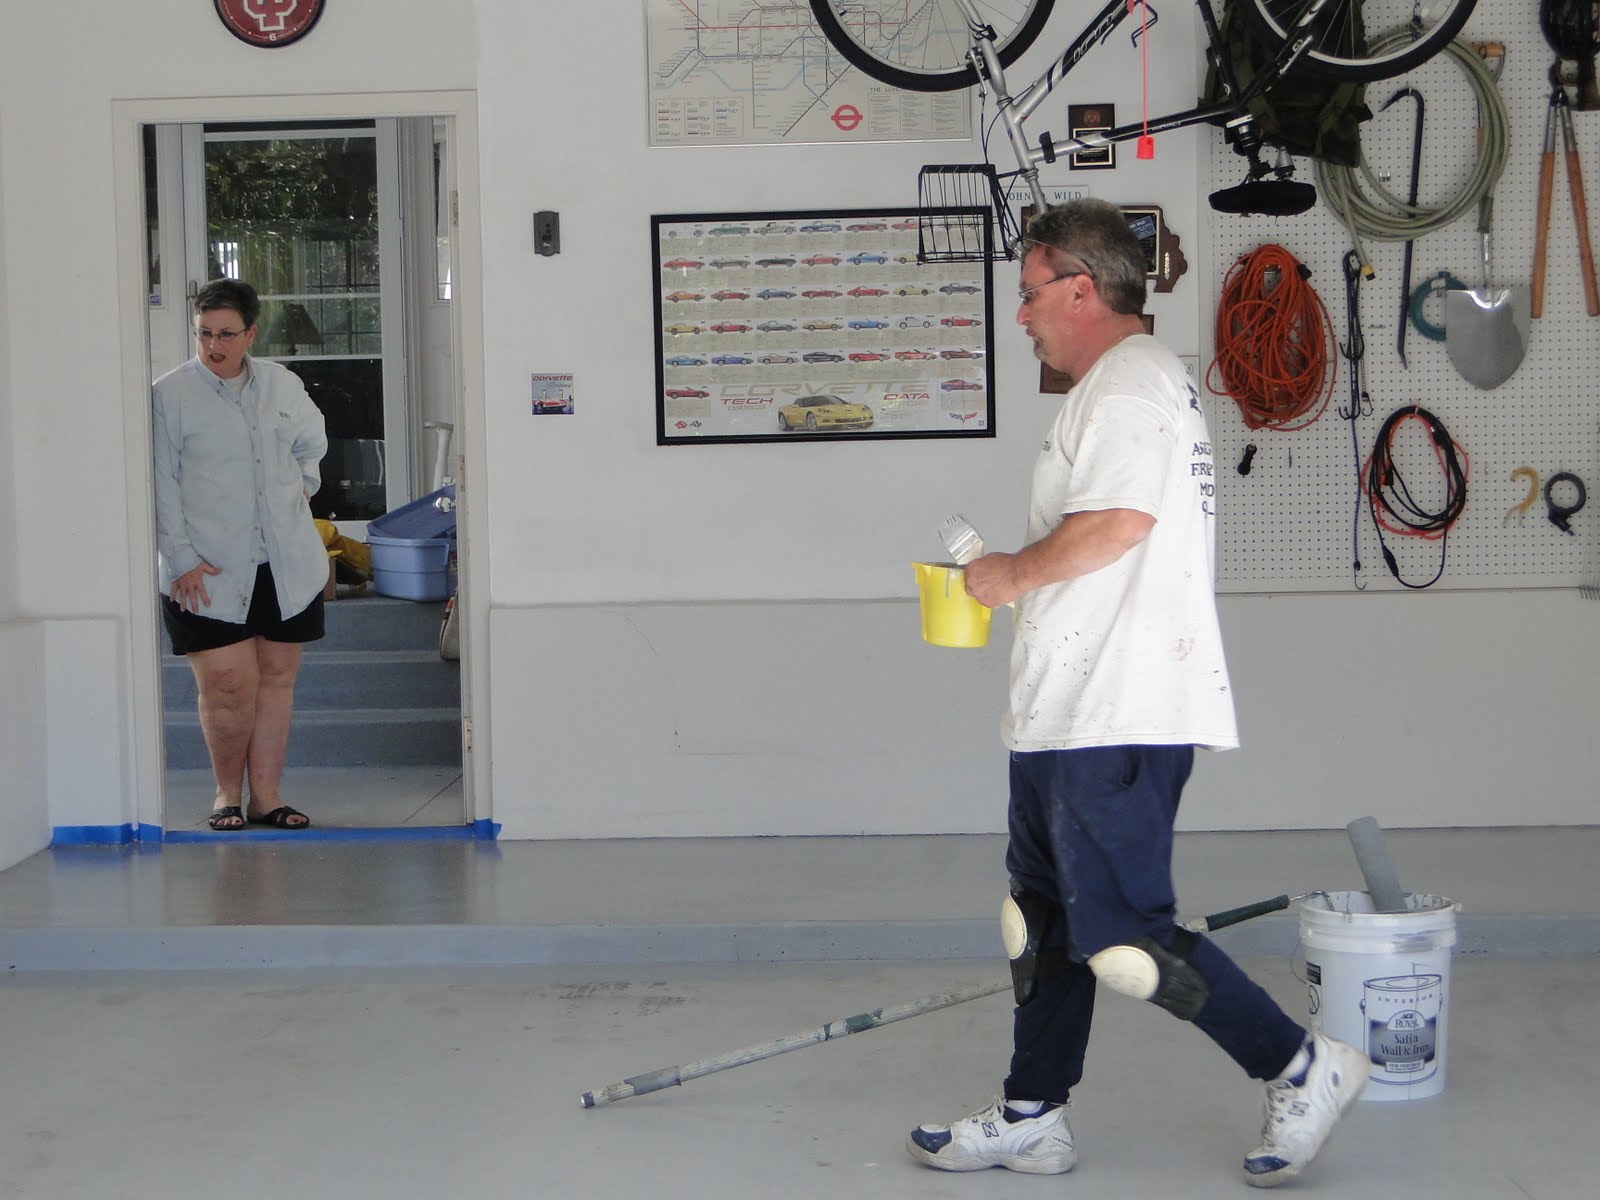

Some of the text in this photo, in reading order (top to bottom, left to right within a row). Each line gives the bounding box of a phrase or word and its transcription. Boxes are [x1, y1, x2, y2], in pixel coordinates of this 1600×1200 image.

[269, 33, 277, 41] 6
[1006, 191, 1031, 200] OHN
[1054, 191, 1082, 200] WILD
[1395, 1019, 1419, 1029] ROYAL
[1394, 1033, 1419, 1044] Satin
[1380, 1043, 1401, 1056] Wall
[1403, 1045, 1410, 1056] &
[982, 1122, 999, 1137] N
